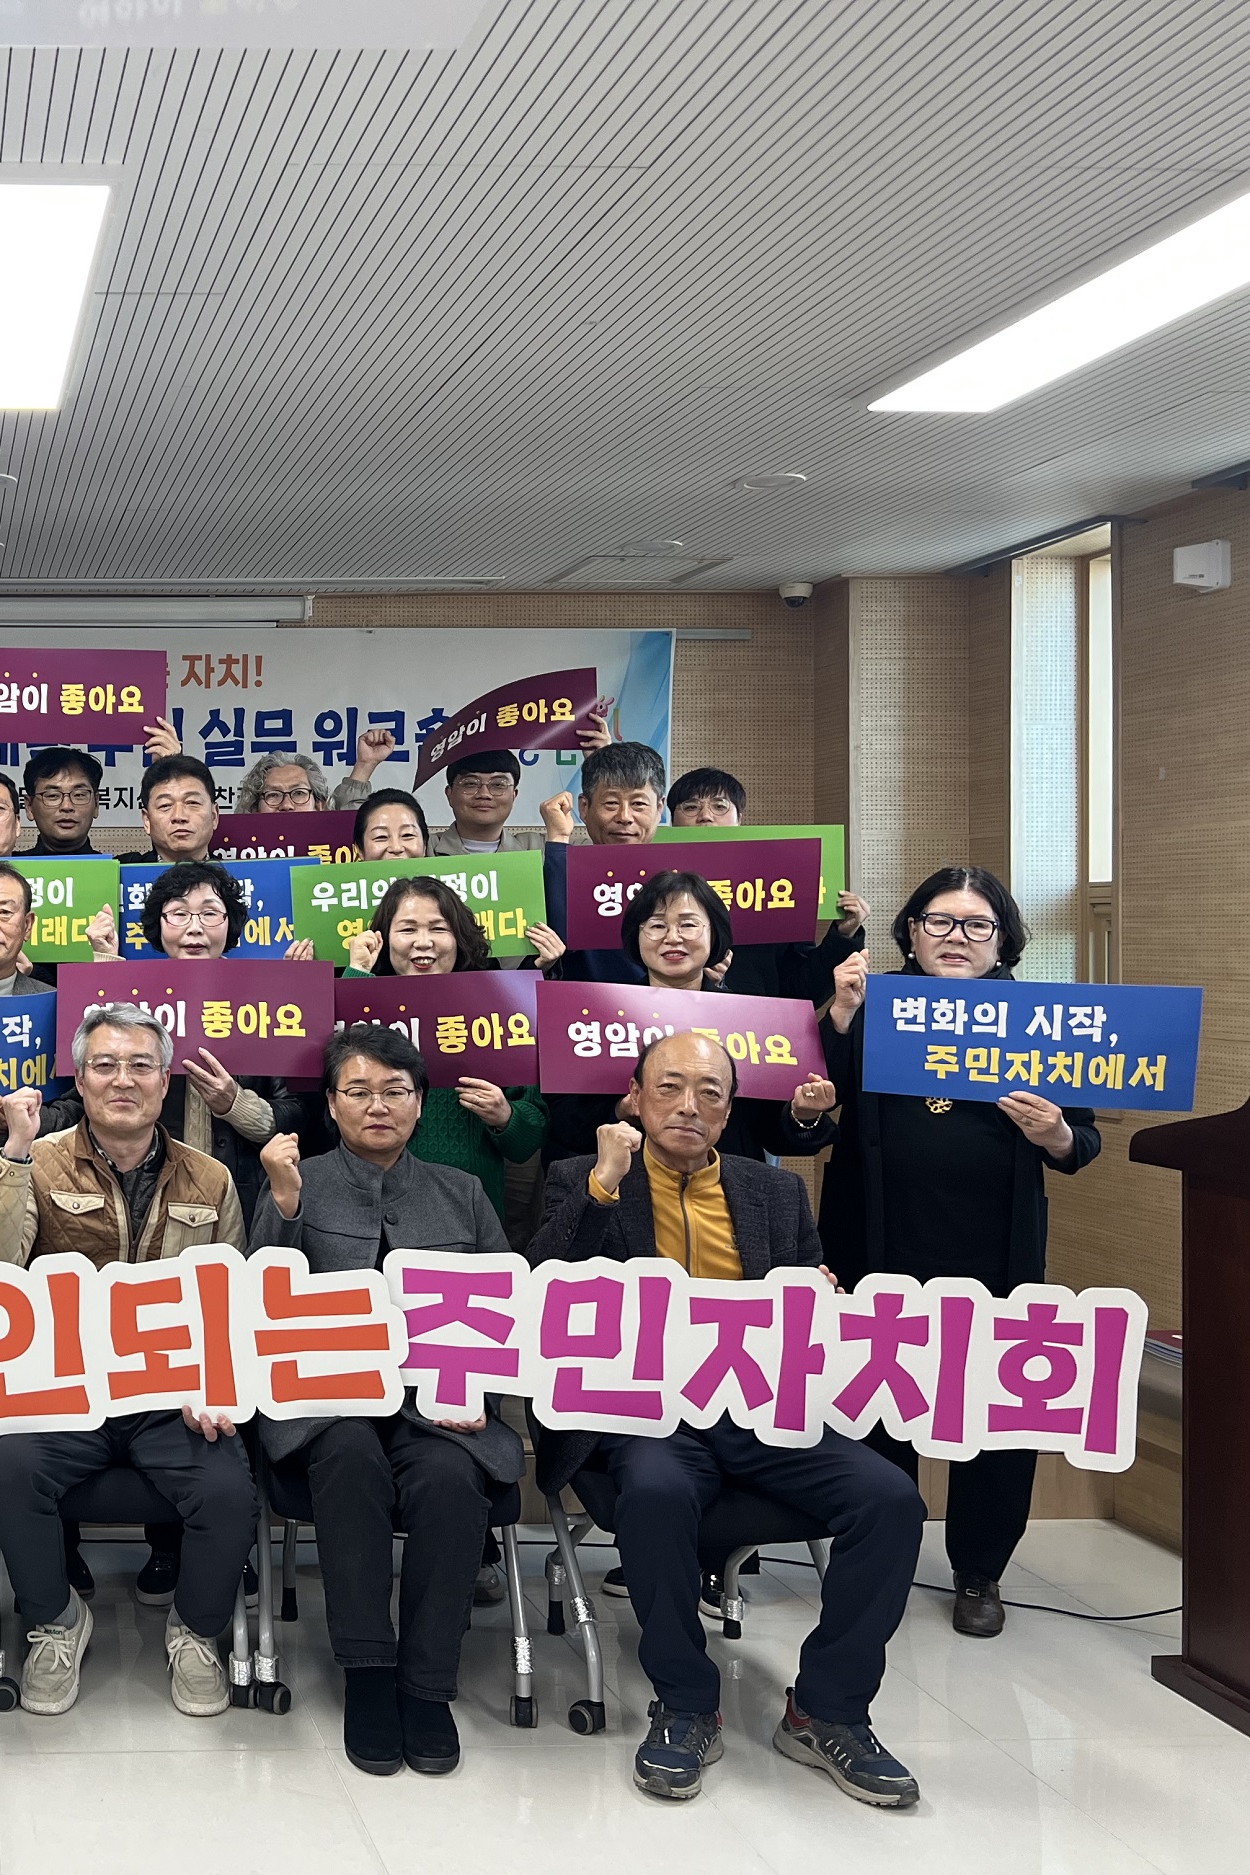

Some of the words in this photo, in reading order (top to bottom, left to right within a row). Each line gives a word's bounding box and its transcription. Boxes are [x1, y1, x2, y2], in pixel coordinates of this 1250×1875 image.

[181, 654, 263, 690] 자치!
[59, 684, 144, 715] 좋아요
[430, 713, 487, 763] 영암이
[496, 698, 576, 727] 좋아요
[422, 870, 500, 902] 정이
[201, 1000, 307, 1039] 좋아요
[435, 1012, 536, 1054] 좋아요
[892, 996, 1009, 1039] 변화의
[1025, 1003, 1119, 1048] 시작,
[924, 1044, 1167, 1092] 주민자치에서
[400, 1266, 1129, 1454] 주민자치회
